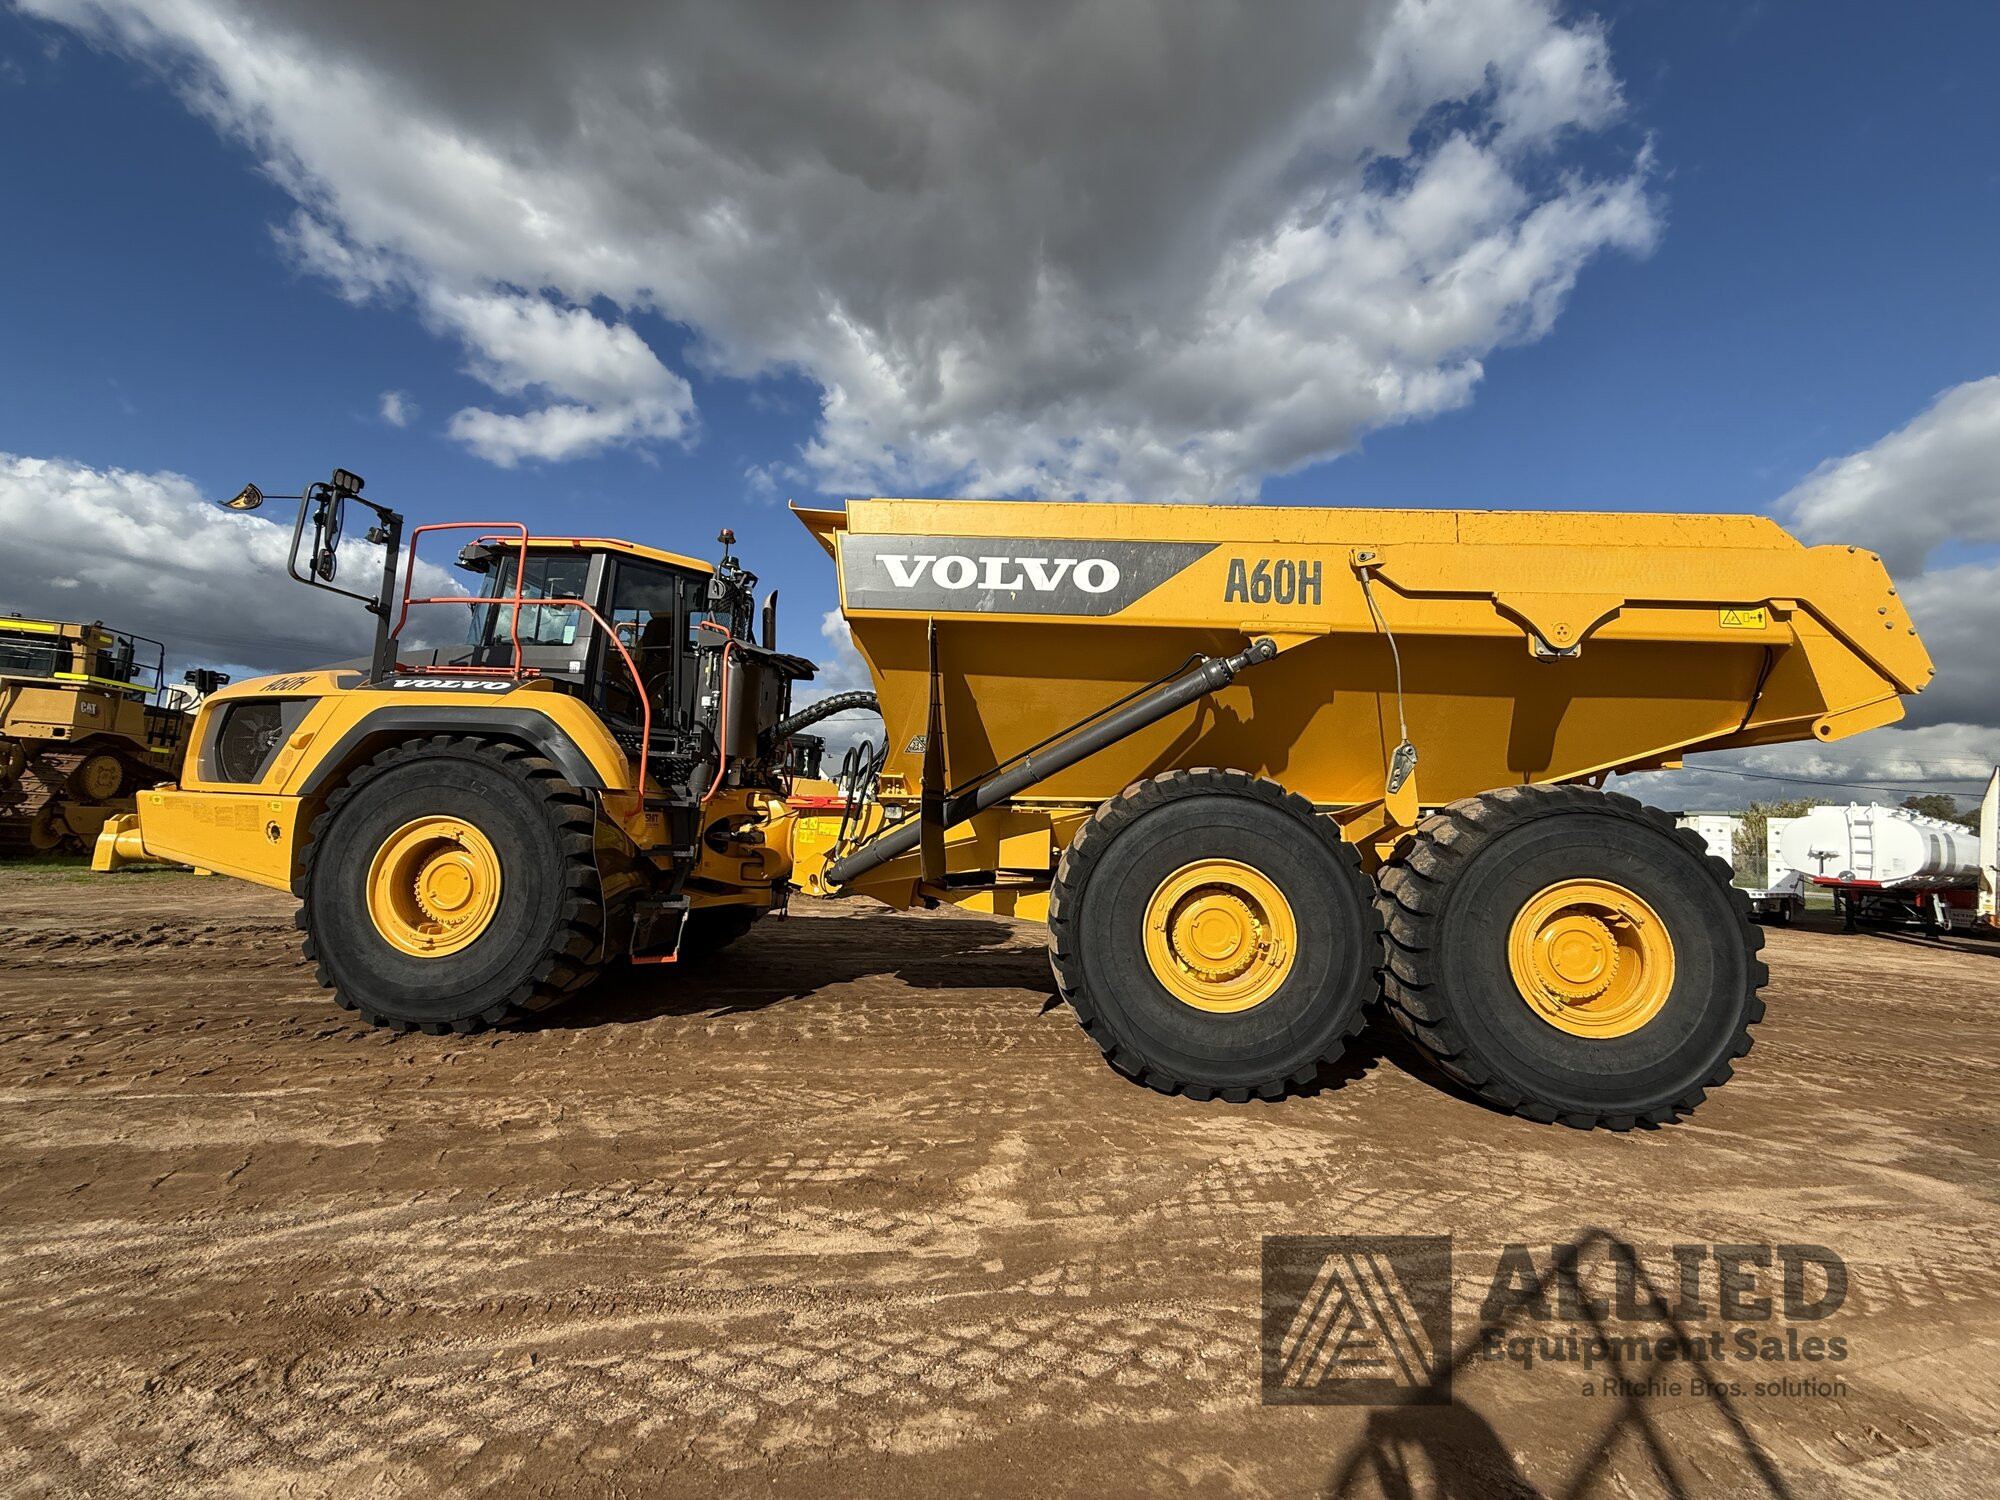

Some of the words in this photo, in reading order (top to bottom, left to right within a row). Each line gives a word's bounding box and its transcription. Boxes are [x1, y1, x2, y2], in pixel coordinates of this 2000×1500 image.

[875, 554, 1121, 593] VOLVO
[1224, 558, 1322, 605] A60H
[393, 679, 511, 690] VOLVO
[80, 701, 97, 715] CAT
